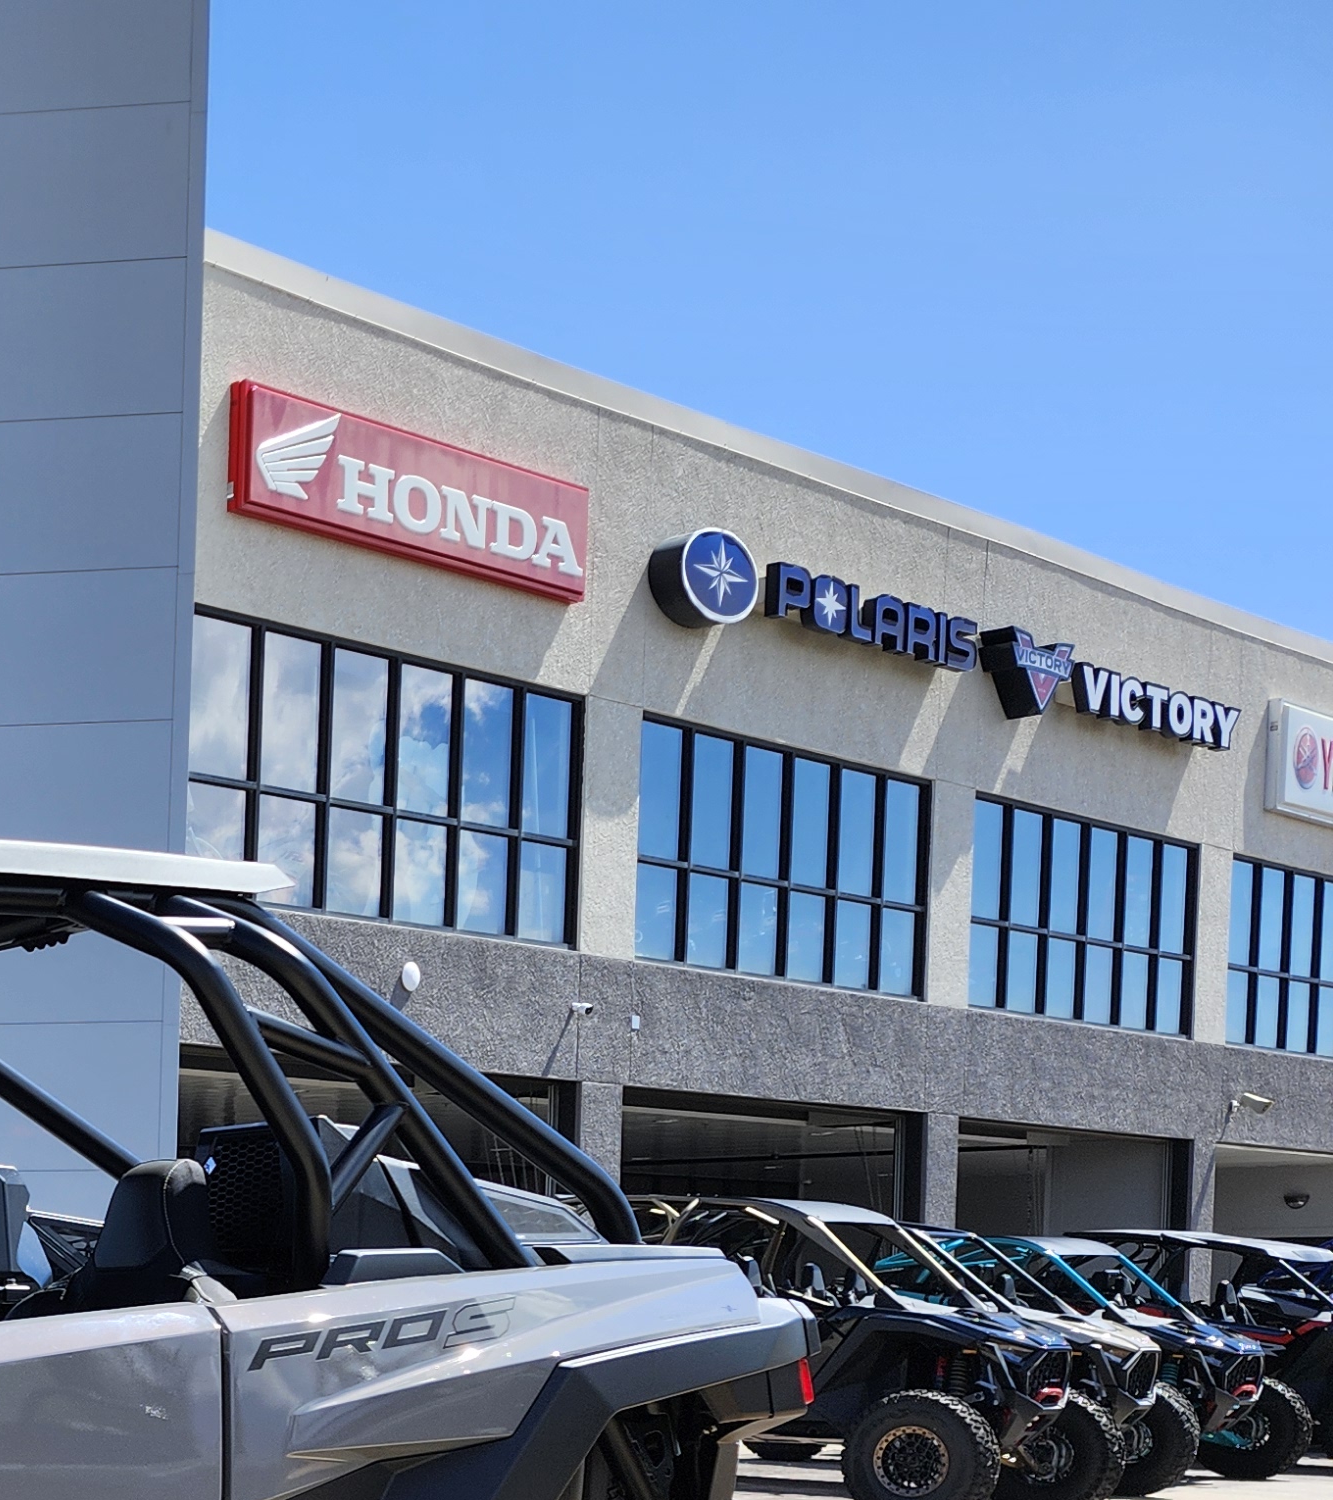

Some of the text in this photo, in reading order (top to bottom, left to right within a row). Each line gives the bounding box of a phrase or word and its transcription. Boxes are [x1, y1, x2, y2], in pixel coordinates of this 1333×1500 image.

[337, 453, 583, 578] HONDA
[778, 561, 978, 672] POLARIS
[1015, 647, 1071, 676] VICTORY
[1082, 664, 1242, 750] VICTORY
